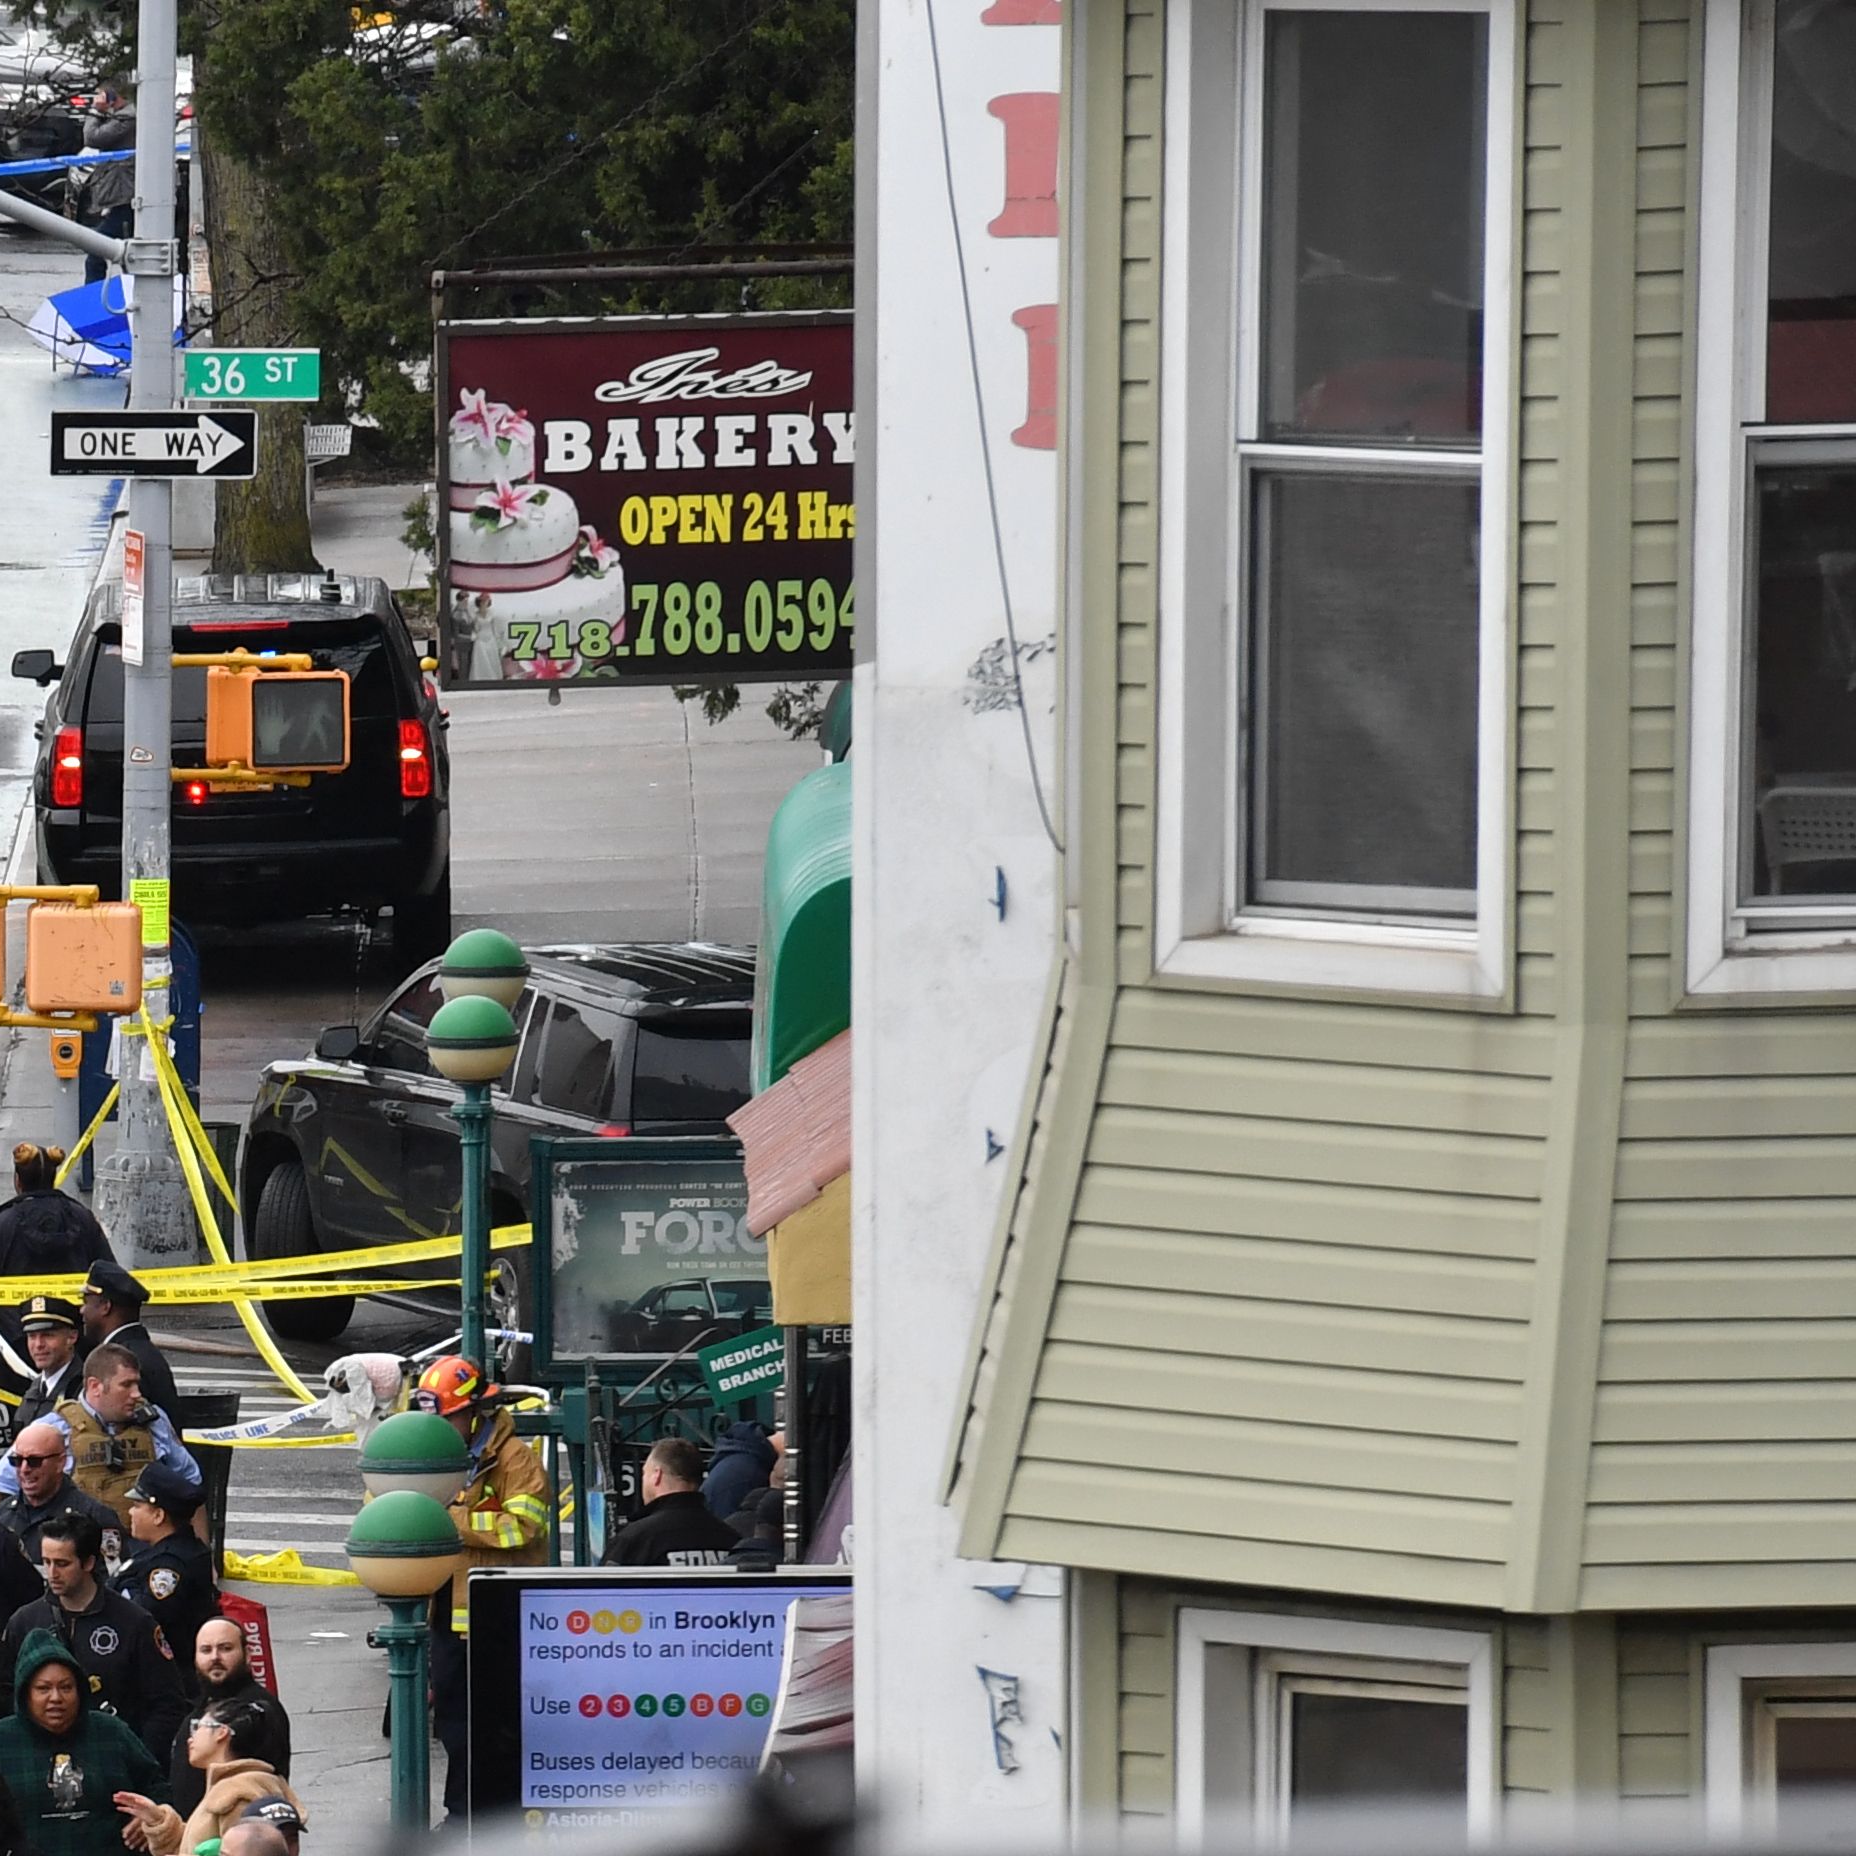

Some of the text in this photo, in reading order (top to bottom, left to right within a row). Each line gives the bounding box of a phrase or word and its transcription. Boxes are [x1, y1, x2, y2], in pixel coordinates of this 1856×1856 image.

[200, 356, 299, 396] 36 ST
[79, 432, 223, 457] ONE WAY
[620, 495, 732, 545] OPEN
[742, 492, 789, 541] 24
[669, 1197, 748, 1209] POWER BOOK
[620, 1210, 769, 1257] FORC
[709, 1336, 786, 1373] MEDICAL
[718, 1358, 786, 1394] BRANCH
[244, 1422, 270, 1438] LINE
[529, 1612, 559, 1630] No
[649, 1611, 667, 1630] in
[674, 1609, 775, 1636] Brooklyn
[245, 1621, 260, 1657] BAG
[529, 1640, 775, 1665] responds to an incident
[530, 1697, 571, 1715] Use
[529, 1751, 684, 1776] Buses delayed
[529, 1778, 718, 1804] response vehicles
